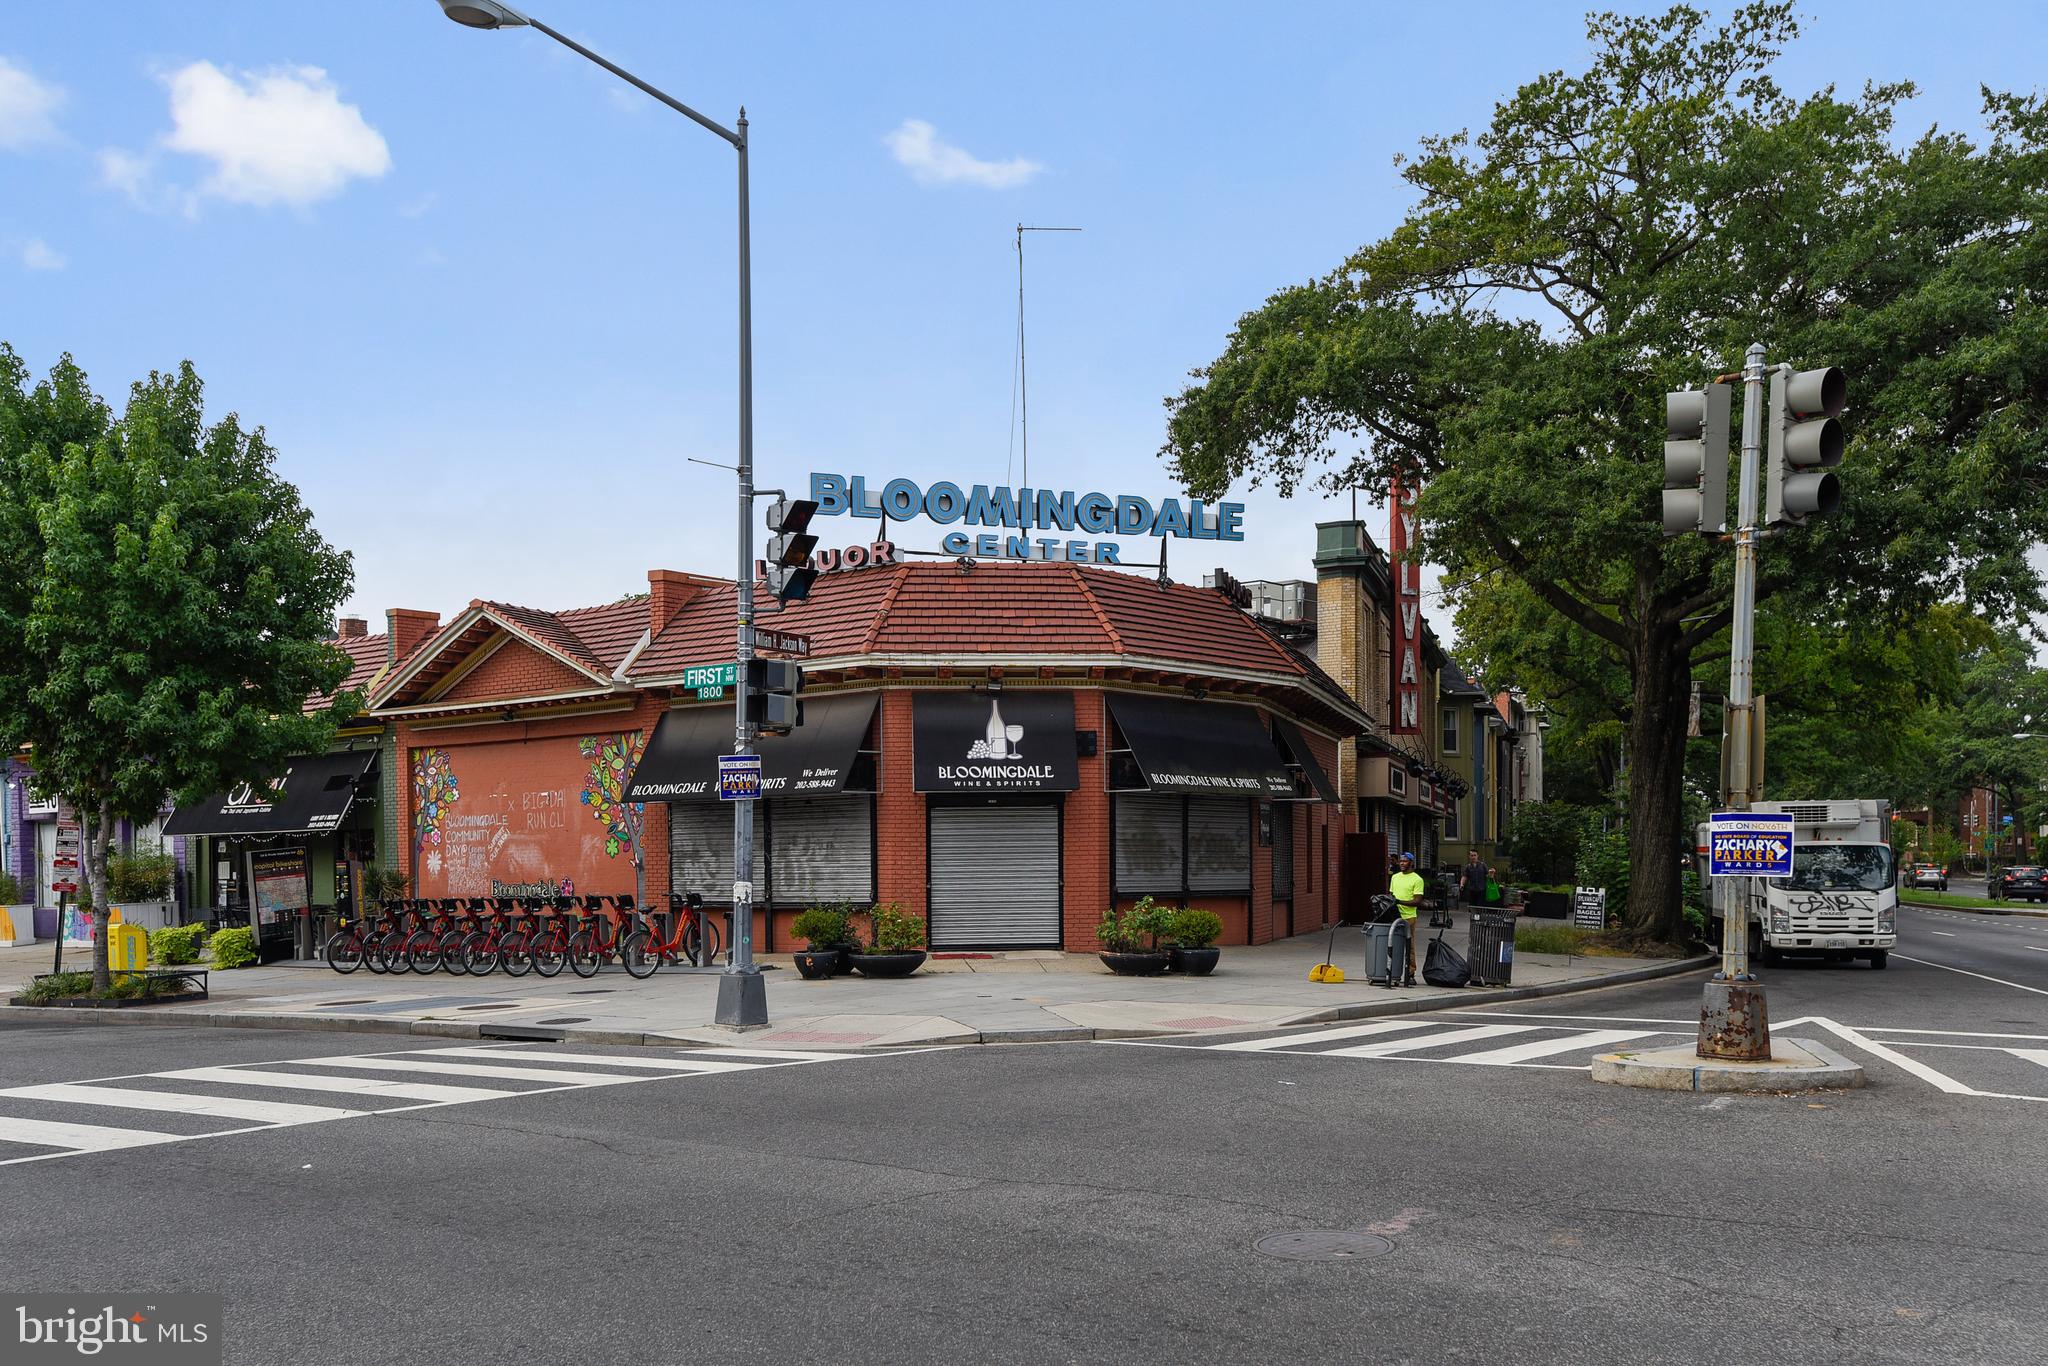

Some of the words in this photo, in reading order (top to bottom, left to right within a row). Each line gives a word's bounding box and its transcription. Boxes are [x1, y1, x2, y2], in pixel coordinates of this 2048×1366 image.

[810, 472, 1244, 541] BLOOMINGDALE
[942, 532, 1121, 564] CENTER
[755, 540, 898, 580] LUOR
[780, 634, 798, 652] Jackson
[687, 667, 723, 686] FIRST
[726, 666, 734, 674] ST
[725, 674, 734, 682] NW
[698, 686, 722, 698] 1800
[803, 769, 813, 777] We
[815, 768, 838, 776] Deliver
[938, 765, 1054, 779] BLOOMINGDALE
[632, 781, 707, 796] BLOOMINGDALE
[1151, 773, 1211, 787] BLOOMINGDALE
[1209, 776, 1231, 787] WINE
[1230, 778, 1237, 788] &
[1236, 778, 1260, 789] SPIRITS
[522, 792, 545, 811] BIG
[445, 814, 509, 830] BLOOMINGDALE
[527, 813, 546, 829] RUN
[445, 829, 491, 843] COMMUNITY
[1715, 839, 1774, 850] ZACHARY
[1715, 850, 1775, 861] PARKER
[491, 878, 560, 897] Bloomingdale
